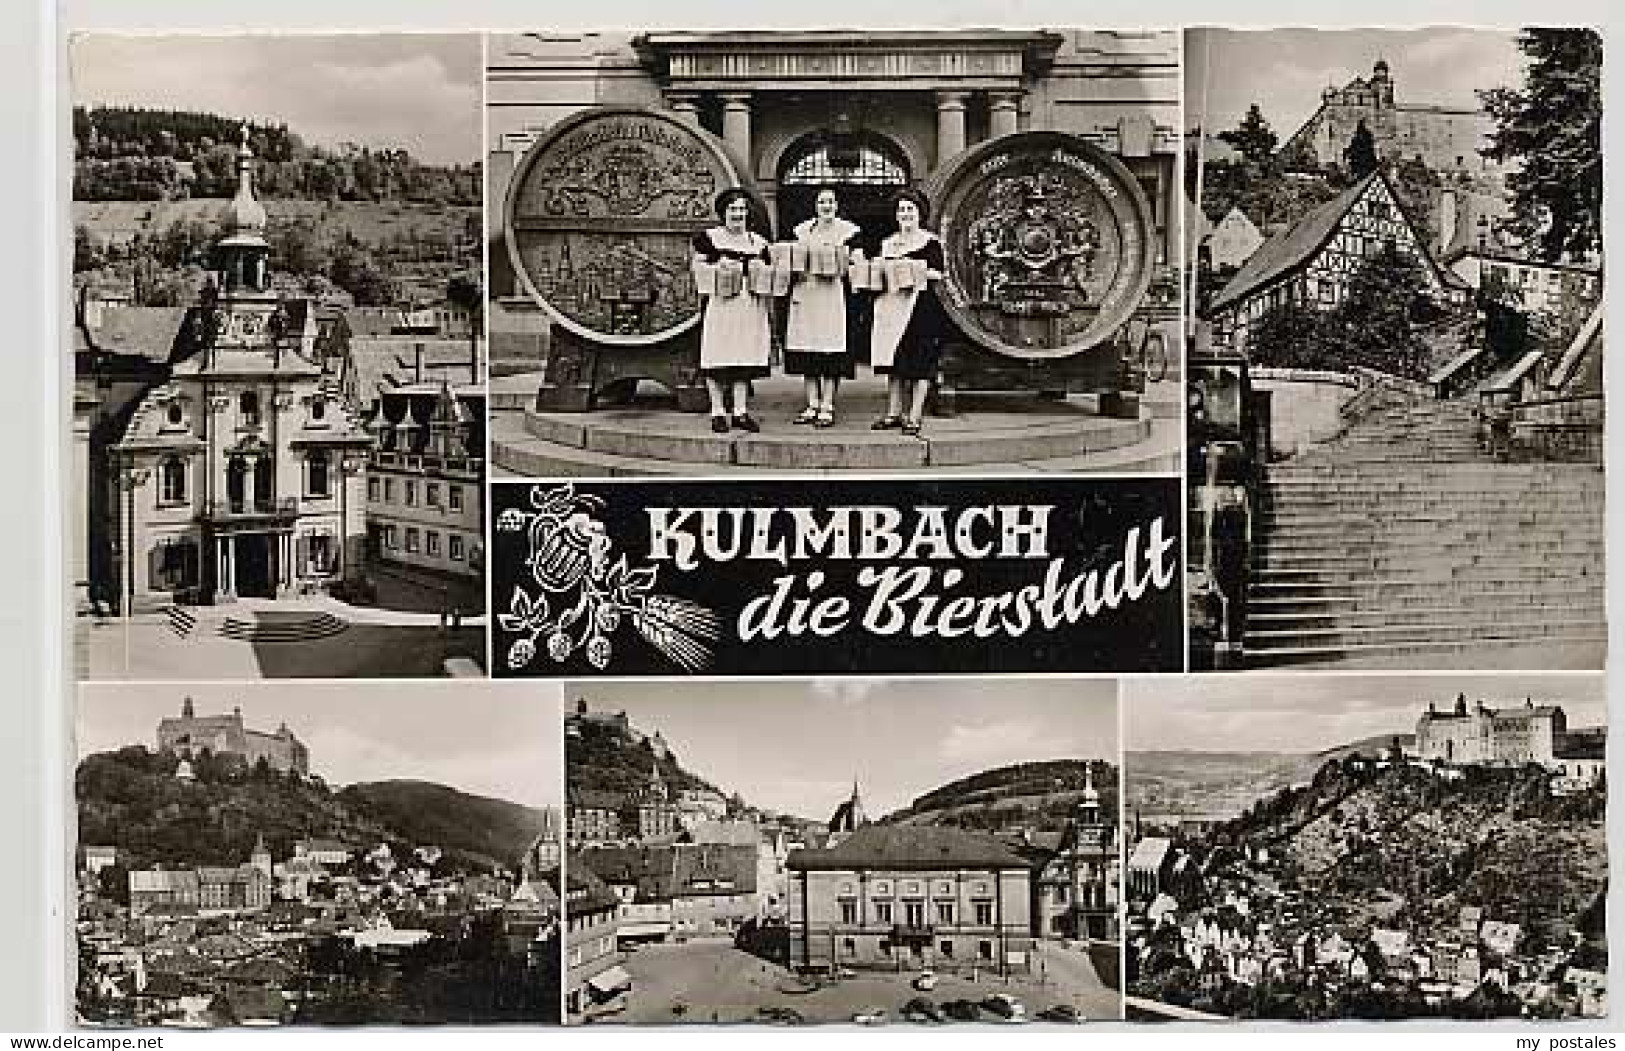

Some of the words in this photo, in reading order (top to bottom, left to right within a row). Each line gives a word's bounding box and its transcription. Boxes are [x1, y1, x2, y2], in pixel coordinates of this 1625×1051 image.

[645, 506, 1055, 570] KULMBACH
[737, 571, 850, 642] die
[857, 517, 1176, 638] Bierstadt
